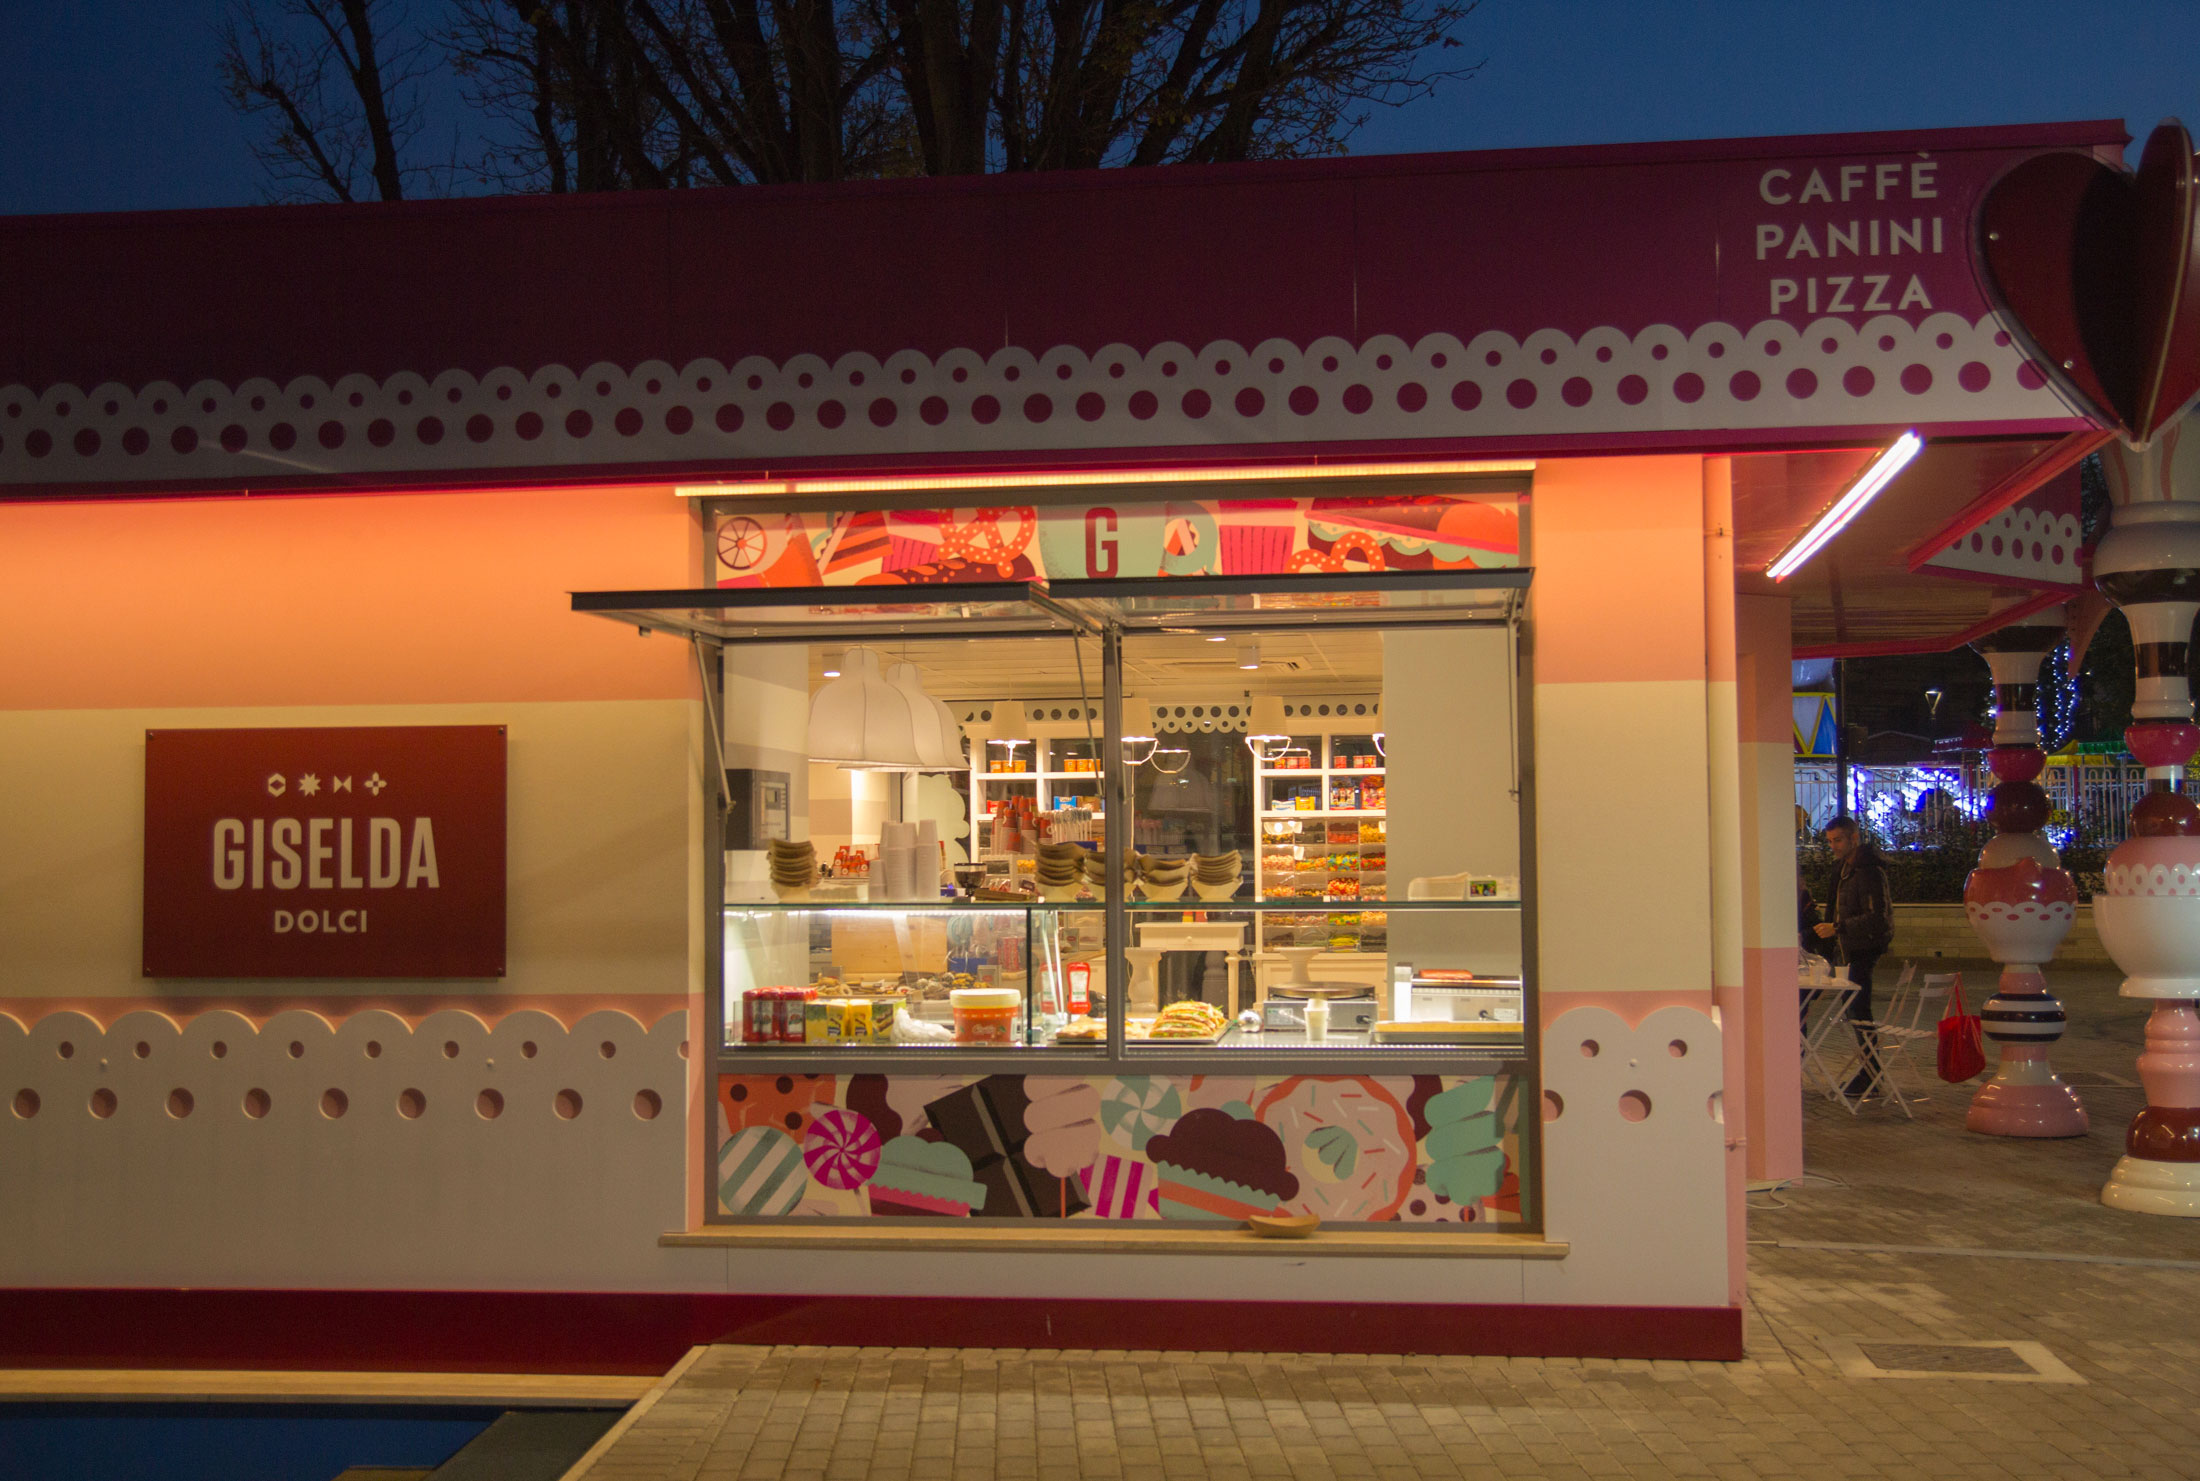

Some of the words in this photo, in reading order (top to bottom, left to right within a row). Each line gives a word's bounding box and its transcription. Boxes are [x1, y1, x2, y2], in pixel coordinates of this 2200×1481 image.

[1759, 152, 1938, 205] CAFFÈ
[1756, 217, 1943, 260] PANINI
[1770, 274, 1933, 315] PIZZA
[1085, 507, 1118, 578] G
[213, 817, 440, 890] GISELDA
[274, 910, 367, 934] DOLCI
